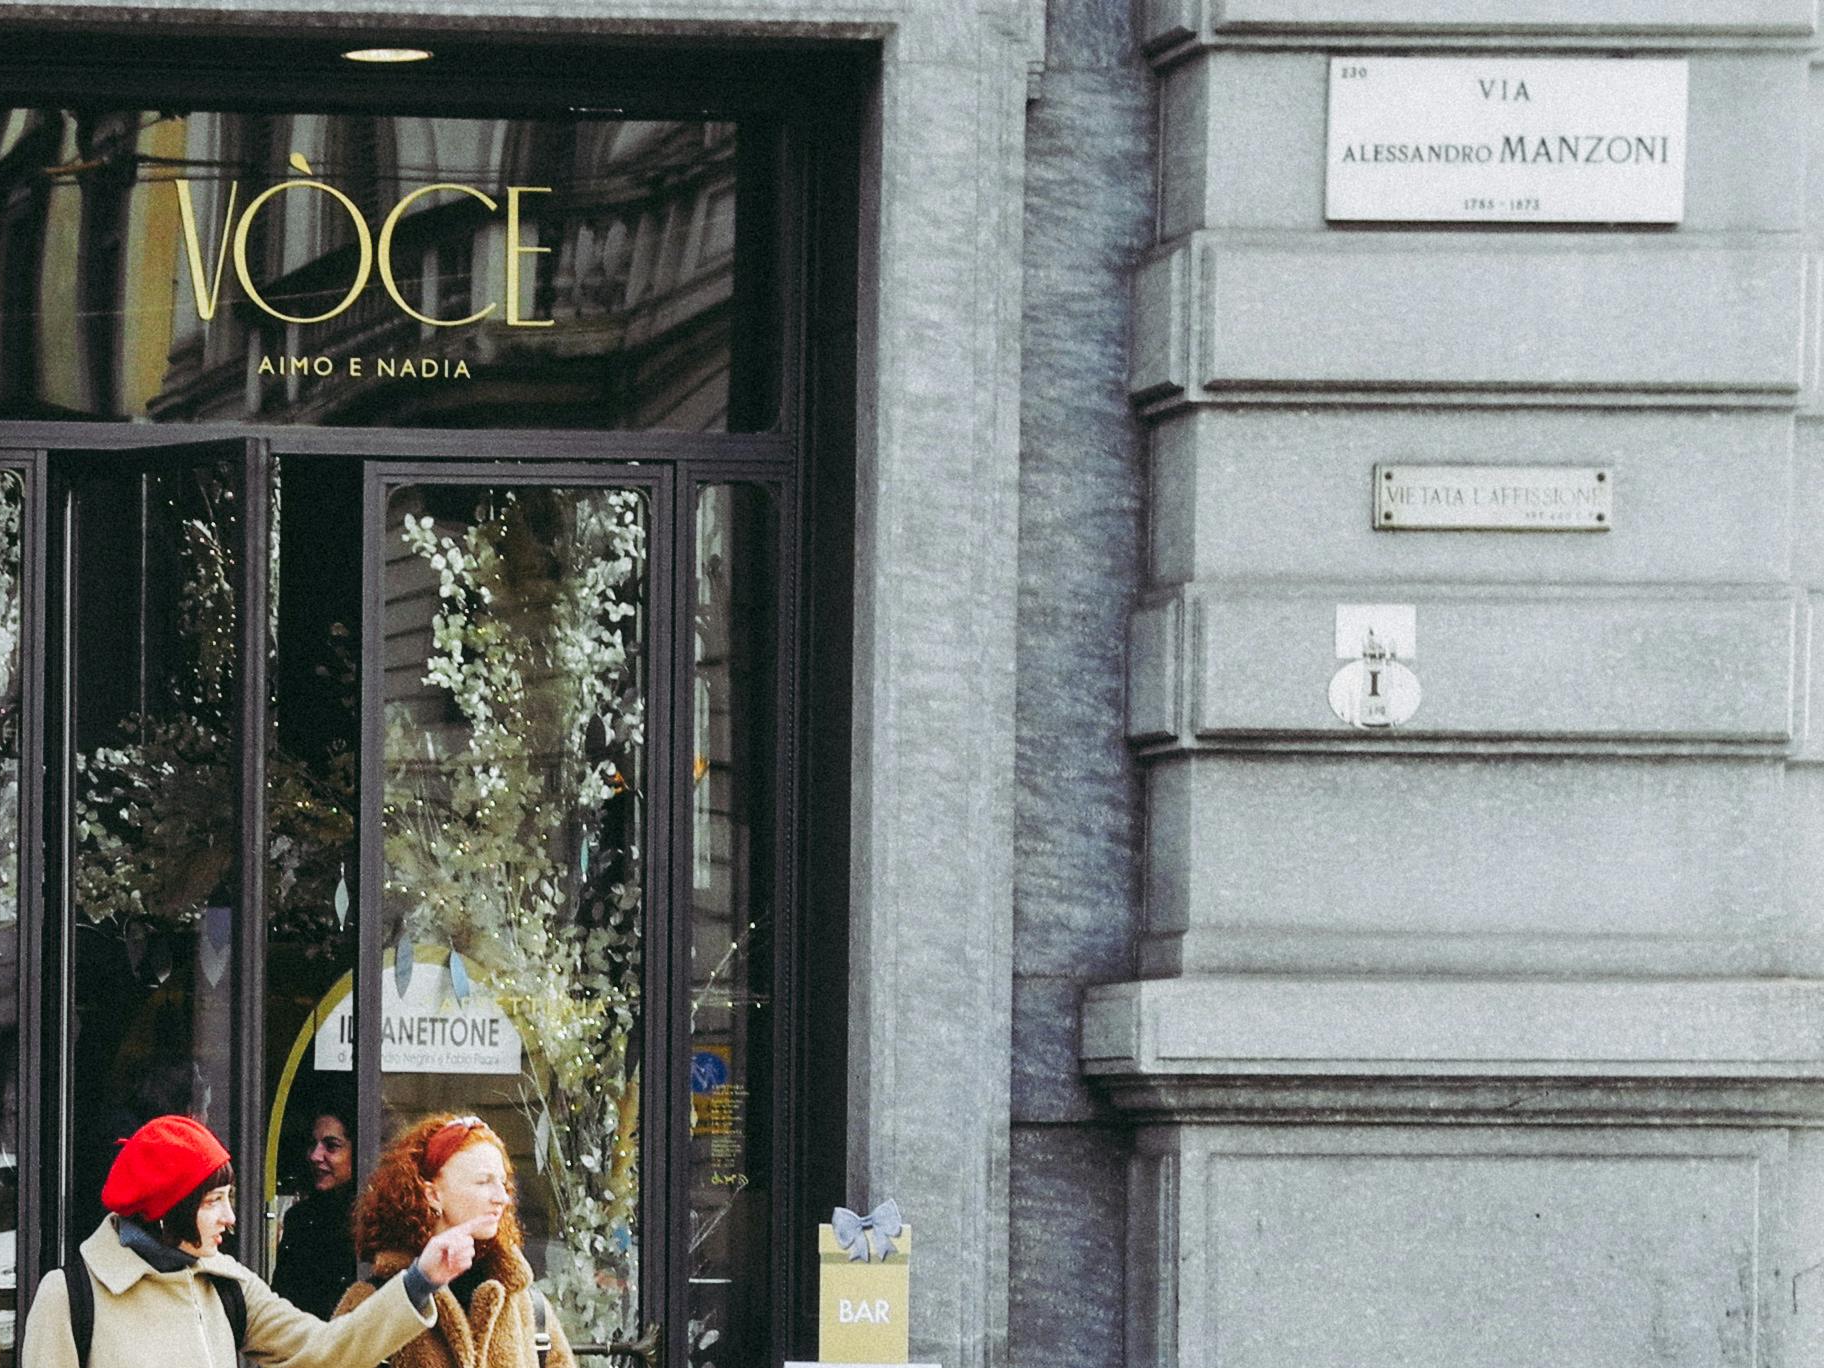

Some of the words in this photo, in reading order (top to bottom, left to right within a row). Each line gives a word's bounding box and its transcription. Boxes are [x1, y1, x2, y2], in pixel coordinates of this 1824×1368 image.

[1341, 66, 1368, 79] 230
[1478, 80, 1530, 101] VIA
[1342, 145, 1493, 163] ALESSANDRO
[1499, 136, 1669, 164] MANZONI
[175, 152, 555, 326] VÒCE
[258, 356, 332, 376] AIMO
[350, 358, 361, 376] E
[377, 358, 471, 378] NADIA
[1386, 486, 1464, 504] VIETATA
[381, 1016, 499, 1047] ANETTONE
[839, 1299, 890, 1324] BAR
